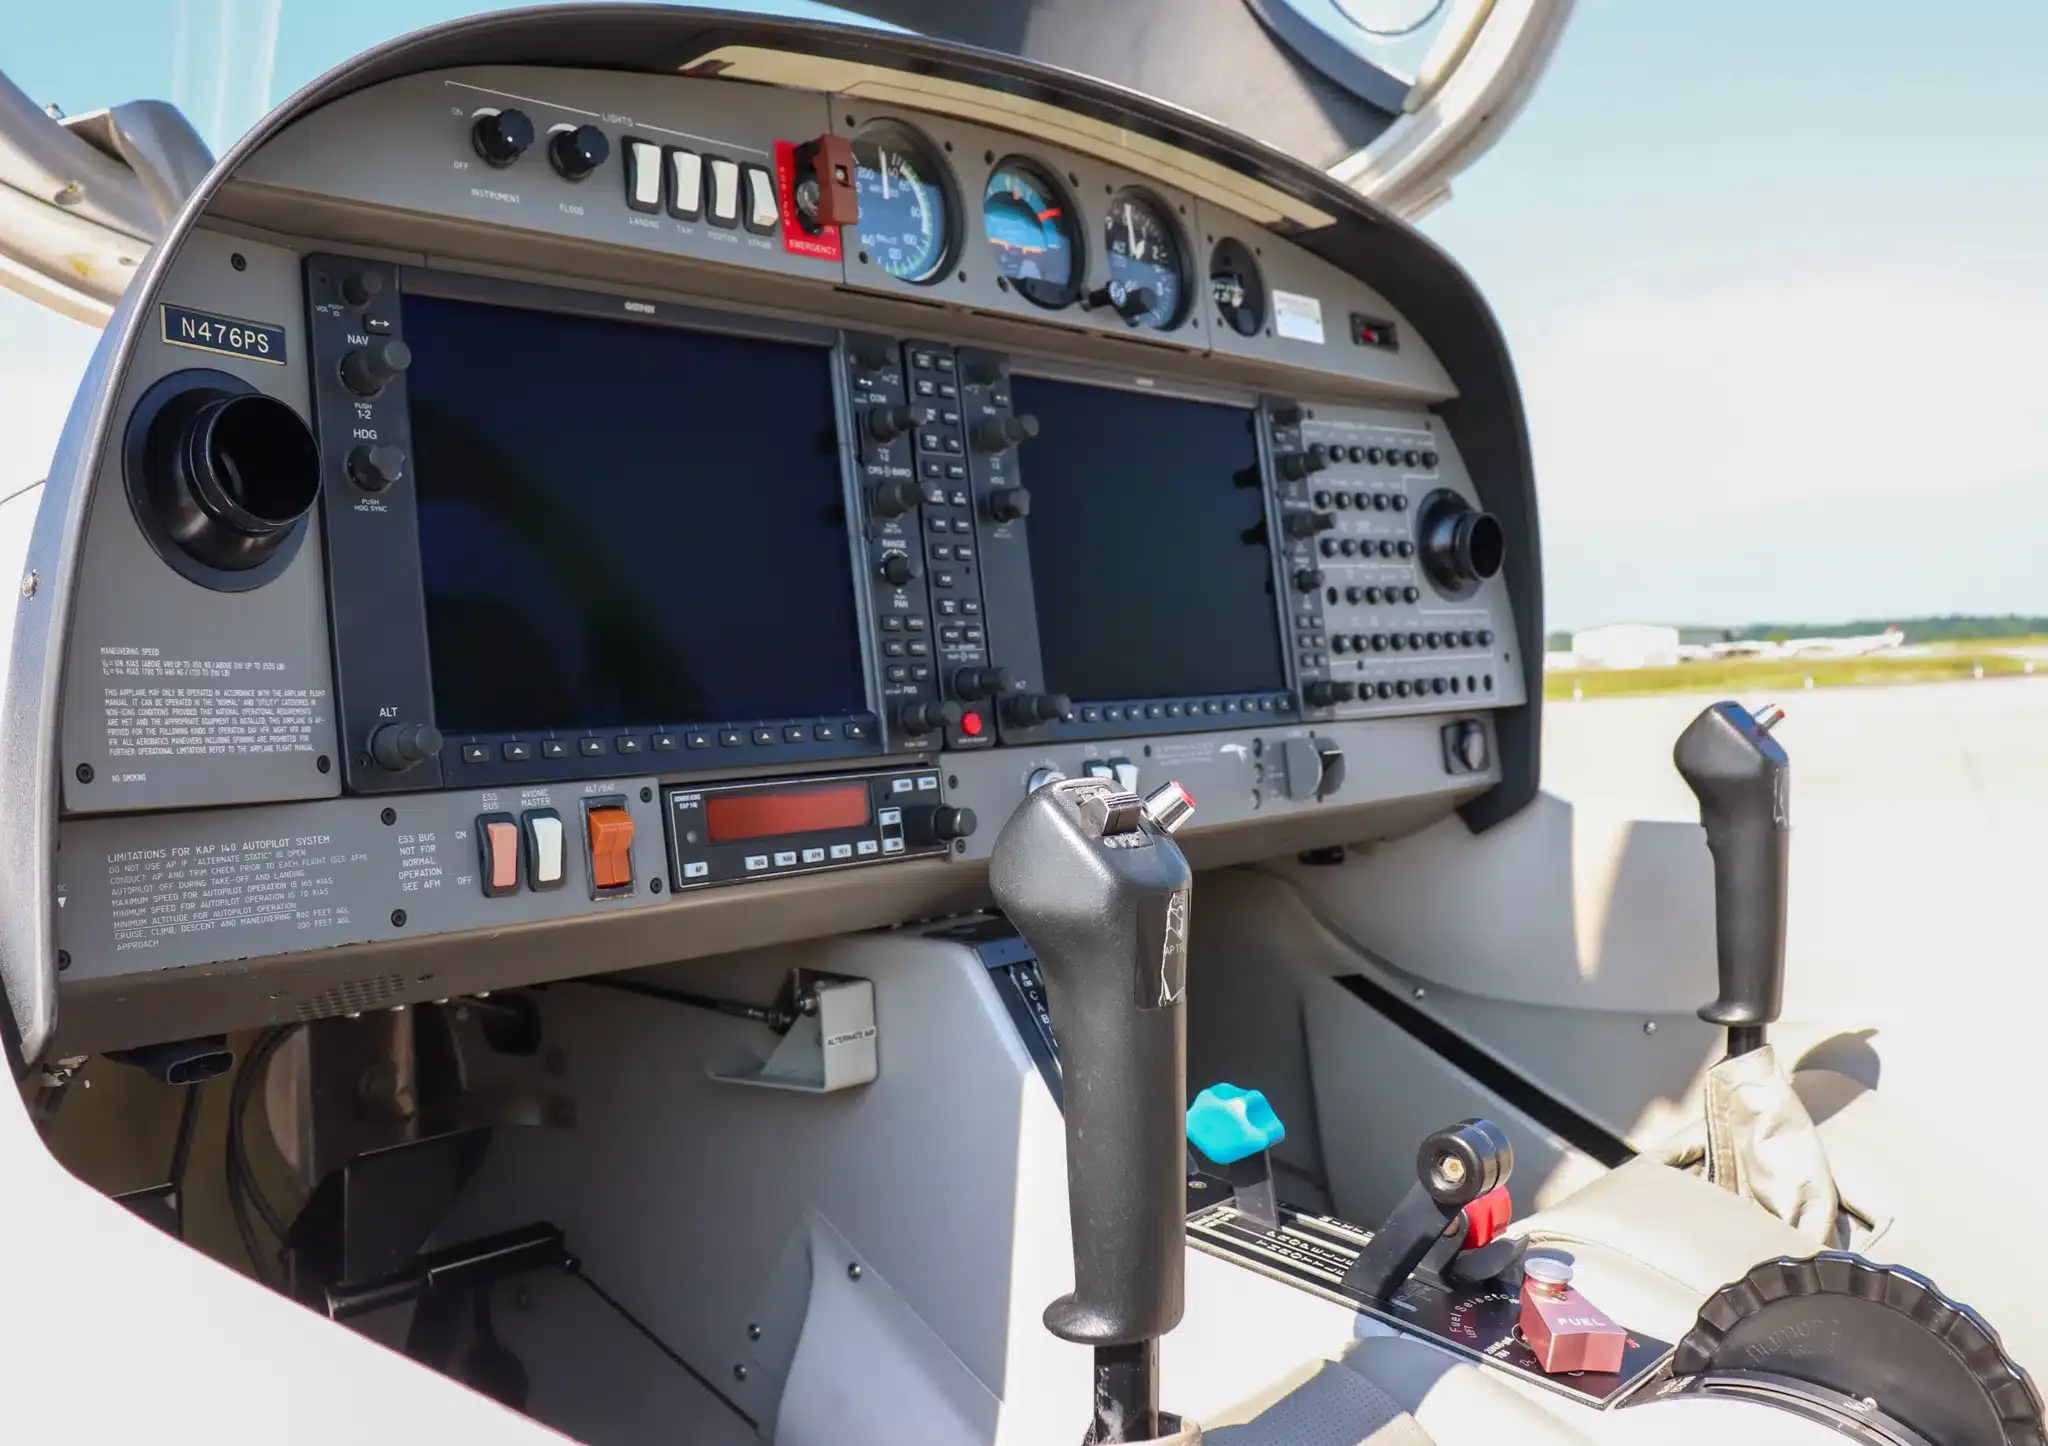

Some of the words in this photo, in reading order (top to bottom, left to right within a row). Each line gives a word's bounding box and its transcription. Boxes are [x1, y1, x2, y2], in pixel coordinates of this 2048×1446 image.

[602, 112, 634, 127] LIGHTS
[453, 161, 469, 170] OFF
[471, 188, 520, 204] INSTRUMENT
[789, 239, 836, 255] EMERGENCY
[181, 317, 269, 353] N476PS
[347, 334, 369, 345] NAV
[354, 402, 372, 410] PUSH
[357, 410, 371, 419] 1-2
[353, 428, 377, 440] HDG
[882, 540, 906, 548] RANGE
[894, 600, 908, 608] PAN
[100, 647, 139, 655] MANEUVERING
[379, 707, 398, 717] ALT
[112, 774, 121, 782] NO
[124, 773, 147, 782] SMOKING
[482, 793, 498, 802] ESS
[521, 788, 549, 798] AVIONIC
[483, 801, 499, 810] BUS
[521, 797, 551, 806] MASTER
[398, 834, 415, 844] ESS
[419, 833, 436, 843] BUS
[455, 831, 467, 839] ON
[107, 849, 166, 863] LIMITATIONS
[172, 847, 190, 857] FOR
[196, 845, 216, 855] KAP
[221, 843, 236, 852] 140
[243, 838, 290, 851] AUTOPILOT
[296, 835, 330, 846] SYSTEM
[399, 846, 416, 855] NOT
[420, 844, 436, 854] FOR
[402, 856, 436, 866] NORMAL
[109, 866, 120, 874] DO
[125, 864, 140, 872] NOT
[145, 862, 160, 871] USE
[166, 861, 177, 869] AP
[110, 875, 146, 885] CONDUCT
[152, 873, 163, 881] AP
[168, 871, 184, 879] AND
[190, 869, 207, 878] TRIM
[211, 867, 235, 875] CHECK
[240, 863, 261, 872] PRIOR
[266, 862, 274, 870] TO
[279, 861, 298, 869] EACH
[302, 857, 326, 866] FLIGHT
[398, 867, 443, 879] OPERATION
[112, 884, 153, 896] AUTOPILOT
[159, 883, 173, 891] OFF
[179, 880, 207, 889] DURING
[211, 875, 250, 885] TAKE-OFF
[255, 873, 270, 881] AND
[274, 870, 305, 880] LANDING
[402, 881, 418, 891] SEE
[424, 879, 441, 889] AFM
[458, 876, 473, 885] OFF
[112, 896, 148, 907] MAXIMUM
[153, 893, 178, 903] SPEED
[183, 891, 198, 899] FOR
[203, 887, 242, 897] AUTOPILOT
[247, 881, 286, 893] OPERATION
[317, 877, 333, 885] KIAS
[113, 908, 146, 917] MINIMUM
[151, 904, 176, 914] SPEED
[181, 902, 196, 910] FOR
[200, 897, 240, 908] AUTOPILOT
[245, 892, 285, 904] OPERATION
[313, 888, 328, 896] KIAS
[114, 919, 147, 929] MINIMUM
[152, 915, 188, 925] ALTITUDE
[193, 912, 208, 920] FOR
[213, 907, 252, 918] AUTOPILOT
[257, 902, 296, 912] OPERATION
[181, 921, 216, 932] DESCENT
[220, 919, 236, 928] AND
[240, 913, 291, 925] MANEUVERING
[314, 908, 331, 917] FEET
[117, 939, 159, 951] APPROACH
[297, 921, 310, 929] 200
[314, 919, 332, 927] FEET
[828, 1031, 864, 1046] ALTERNATE
[1266, 1230, 1354, 1266] PROPELLE
[1256, 1239, 1346, 1276] THROTTLE
[1449, 1312, 1462, 1333] Fuel
[1557, 1317, 1606, 1326] FUEL
